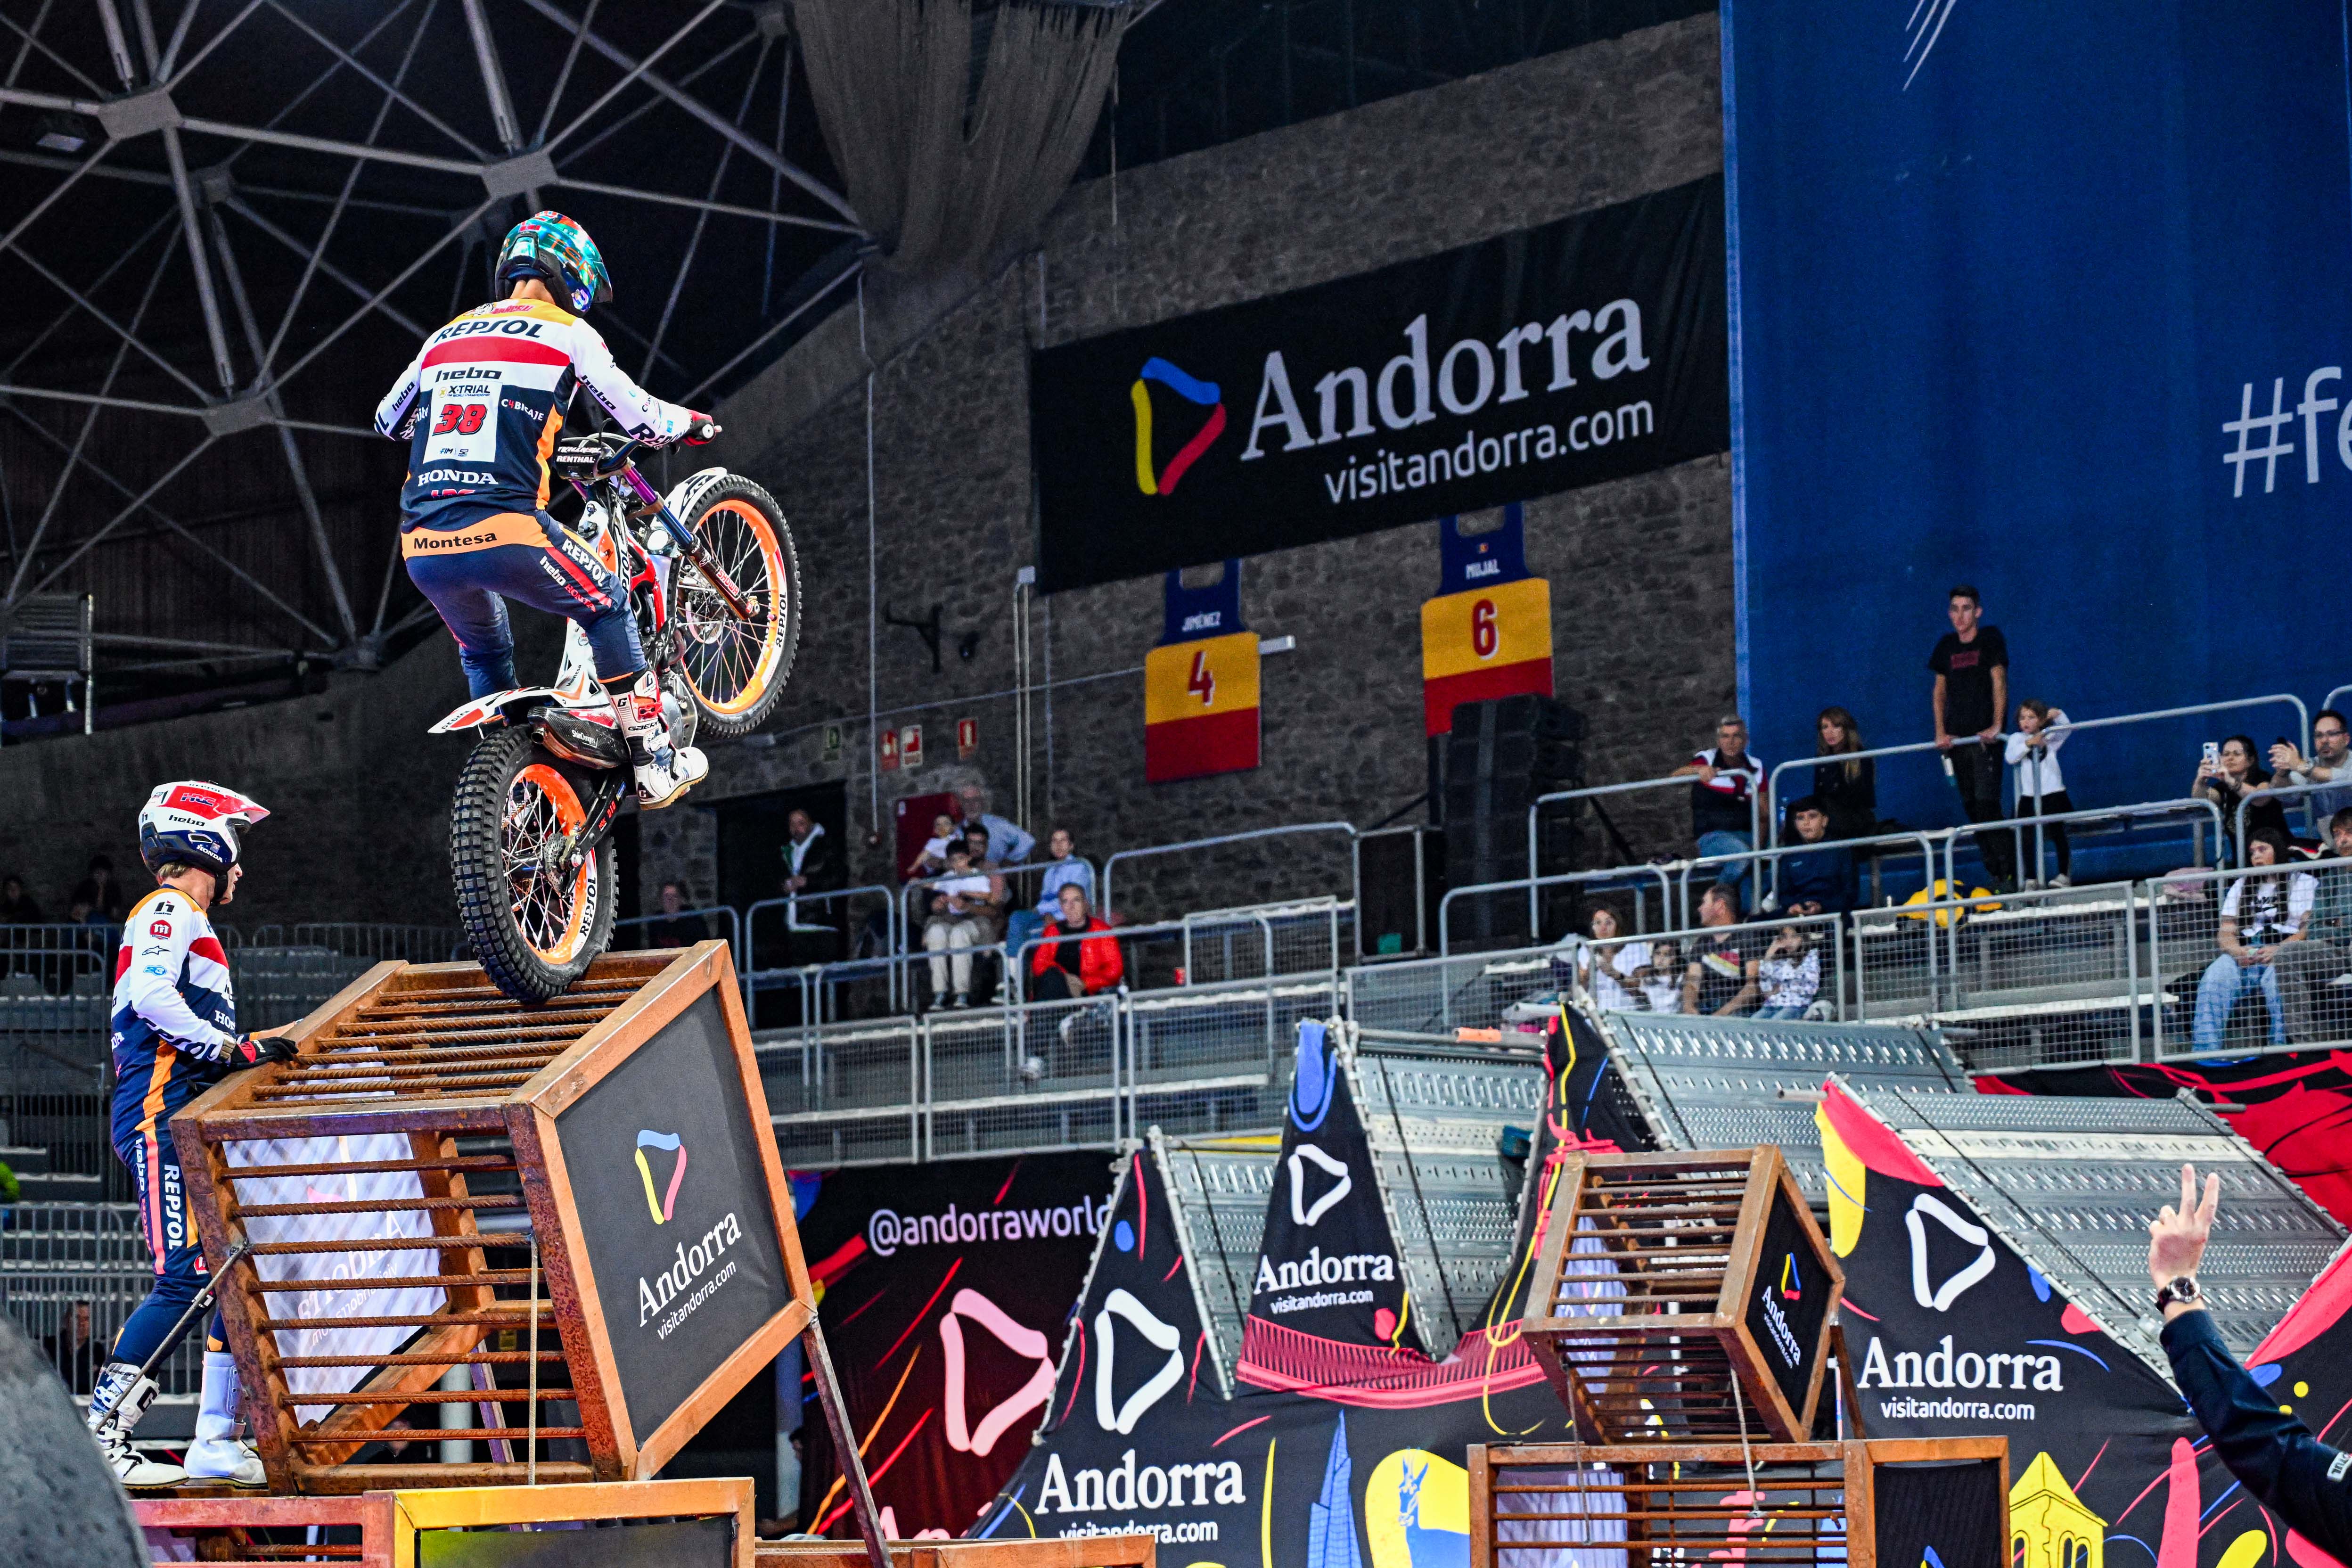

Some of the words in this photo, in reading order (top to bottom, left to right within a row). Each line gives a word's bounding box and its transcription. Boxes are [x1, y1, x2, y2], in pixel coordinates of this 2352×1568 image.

[434, 320, 543, 344] REPSOL
[435, 367, 502, 383] hebo
[581, 375, 616, 410] hebo
[1241, 297, 1650, 461] Andorra
[392, 381, 415, 412] hebo
[432, 404, 487, 436] 38
[1325, 400, 1654, 504] visitandorra.com
[418, 468, 499, 487] HONDA
[414, 532, 497, 550] Montesa
[540, 555, 566, 586] hebo
[562, 538, 606, 587] REPSOL
[564, 583, 596, 613] HONDA
[717, 569, 740, 596] SHOWA
[775, 591, 787, 648] REPSOL
[1471, 598, 1500, 660] 6
[566, 665, 582, 687] Montesa
[1188, 650, 1215, 706] 4
[617, 698, 627, 707] G
[180, 792, 216, 806] HRC
[168, 814, 205, 827] hebo
[196, 844, 223, 863] HONDA
[580, 877, 596, 937] REPSOL
[164, 1164, 183, 1250] REPSOL
[869, 1194, 1114, 1256] @andorraworld
[639, 1213, 742, 1327] Andorra
[1253, 1247, 1395, 1295] Andorra
[657, 1261, 737, 1339] visitandorra.com
[1762, 1285, 1801, 1366] Andorra
[1857, 1335, 2063, 1392] Andorra
[1881, 1396, 2035, 1420] visitandorra.com
[1034, 1448, 1246, 1514] Andorra
